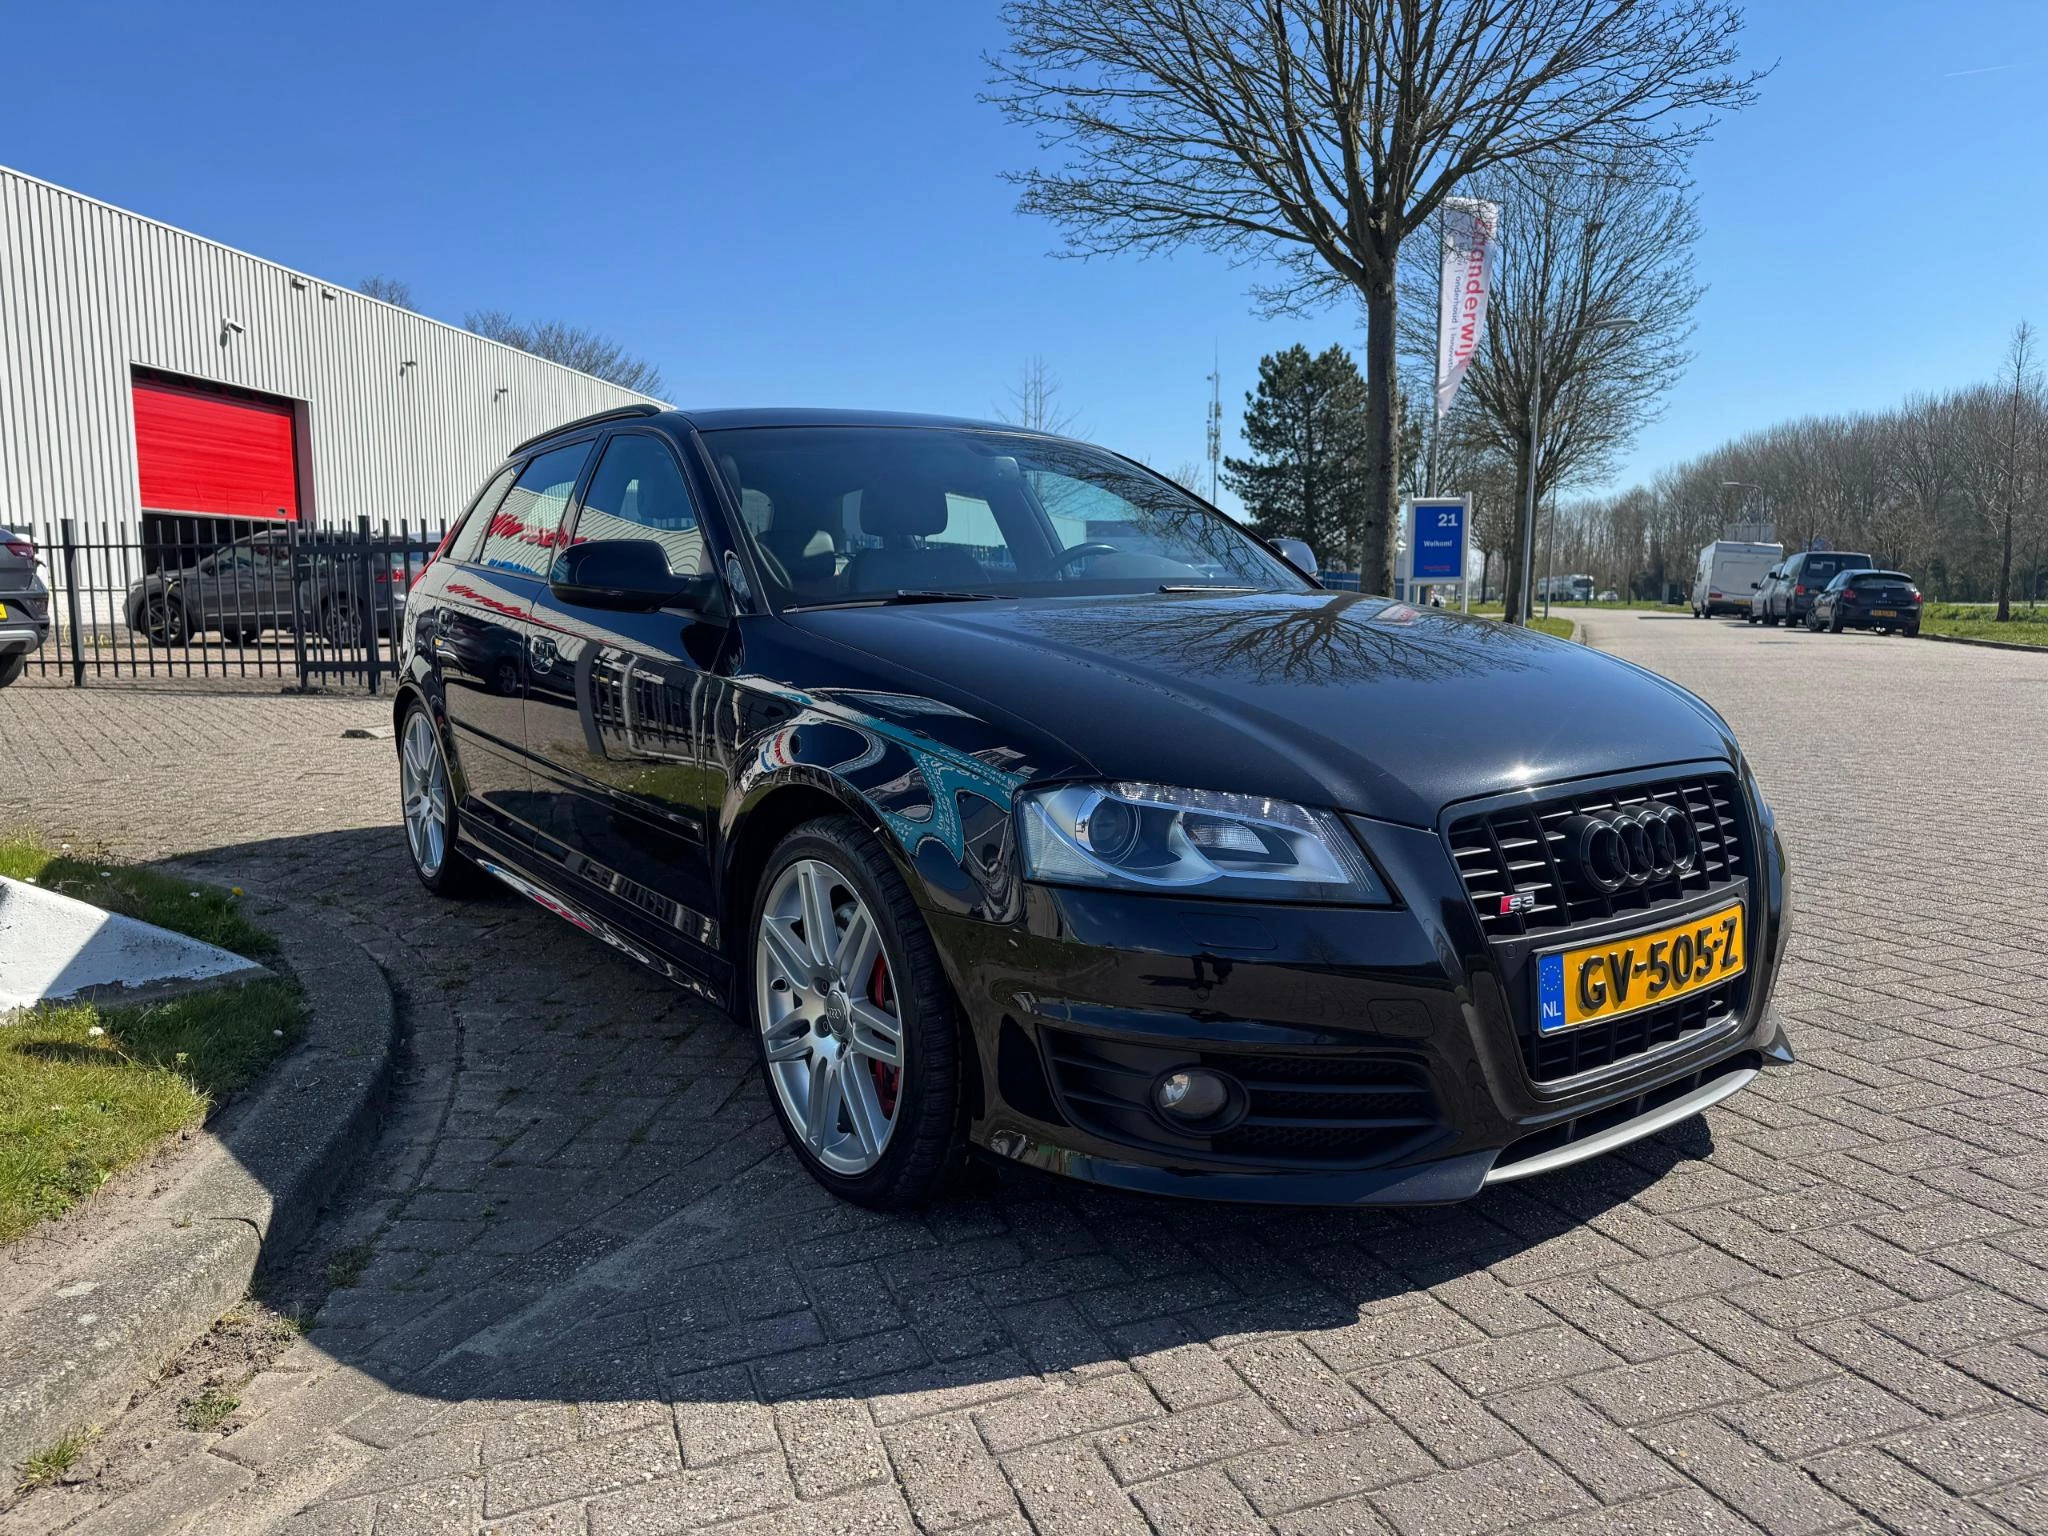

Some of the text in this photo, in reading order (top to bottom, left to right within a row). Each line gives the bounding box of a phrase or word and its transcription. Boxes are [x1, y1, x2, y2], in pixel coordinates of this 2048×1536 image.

[1451, 276, 1461, 323] onderhoud
[1447, 333, 1456, 368] innovati
[1438, 513, 1458, 527] 21
[1508, 895, 1536, 912] S3
[1580, 916, 1738, 1010] GV-505-Z
[1543, 1002, 1561, 1019] NL
